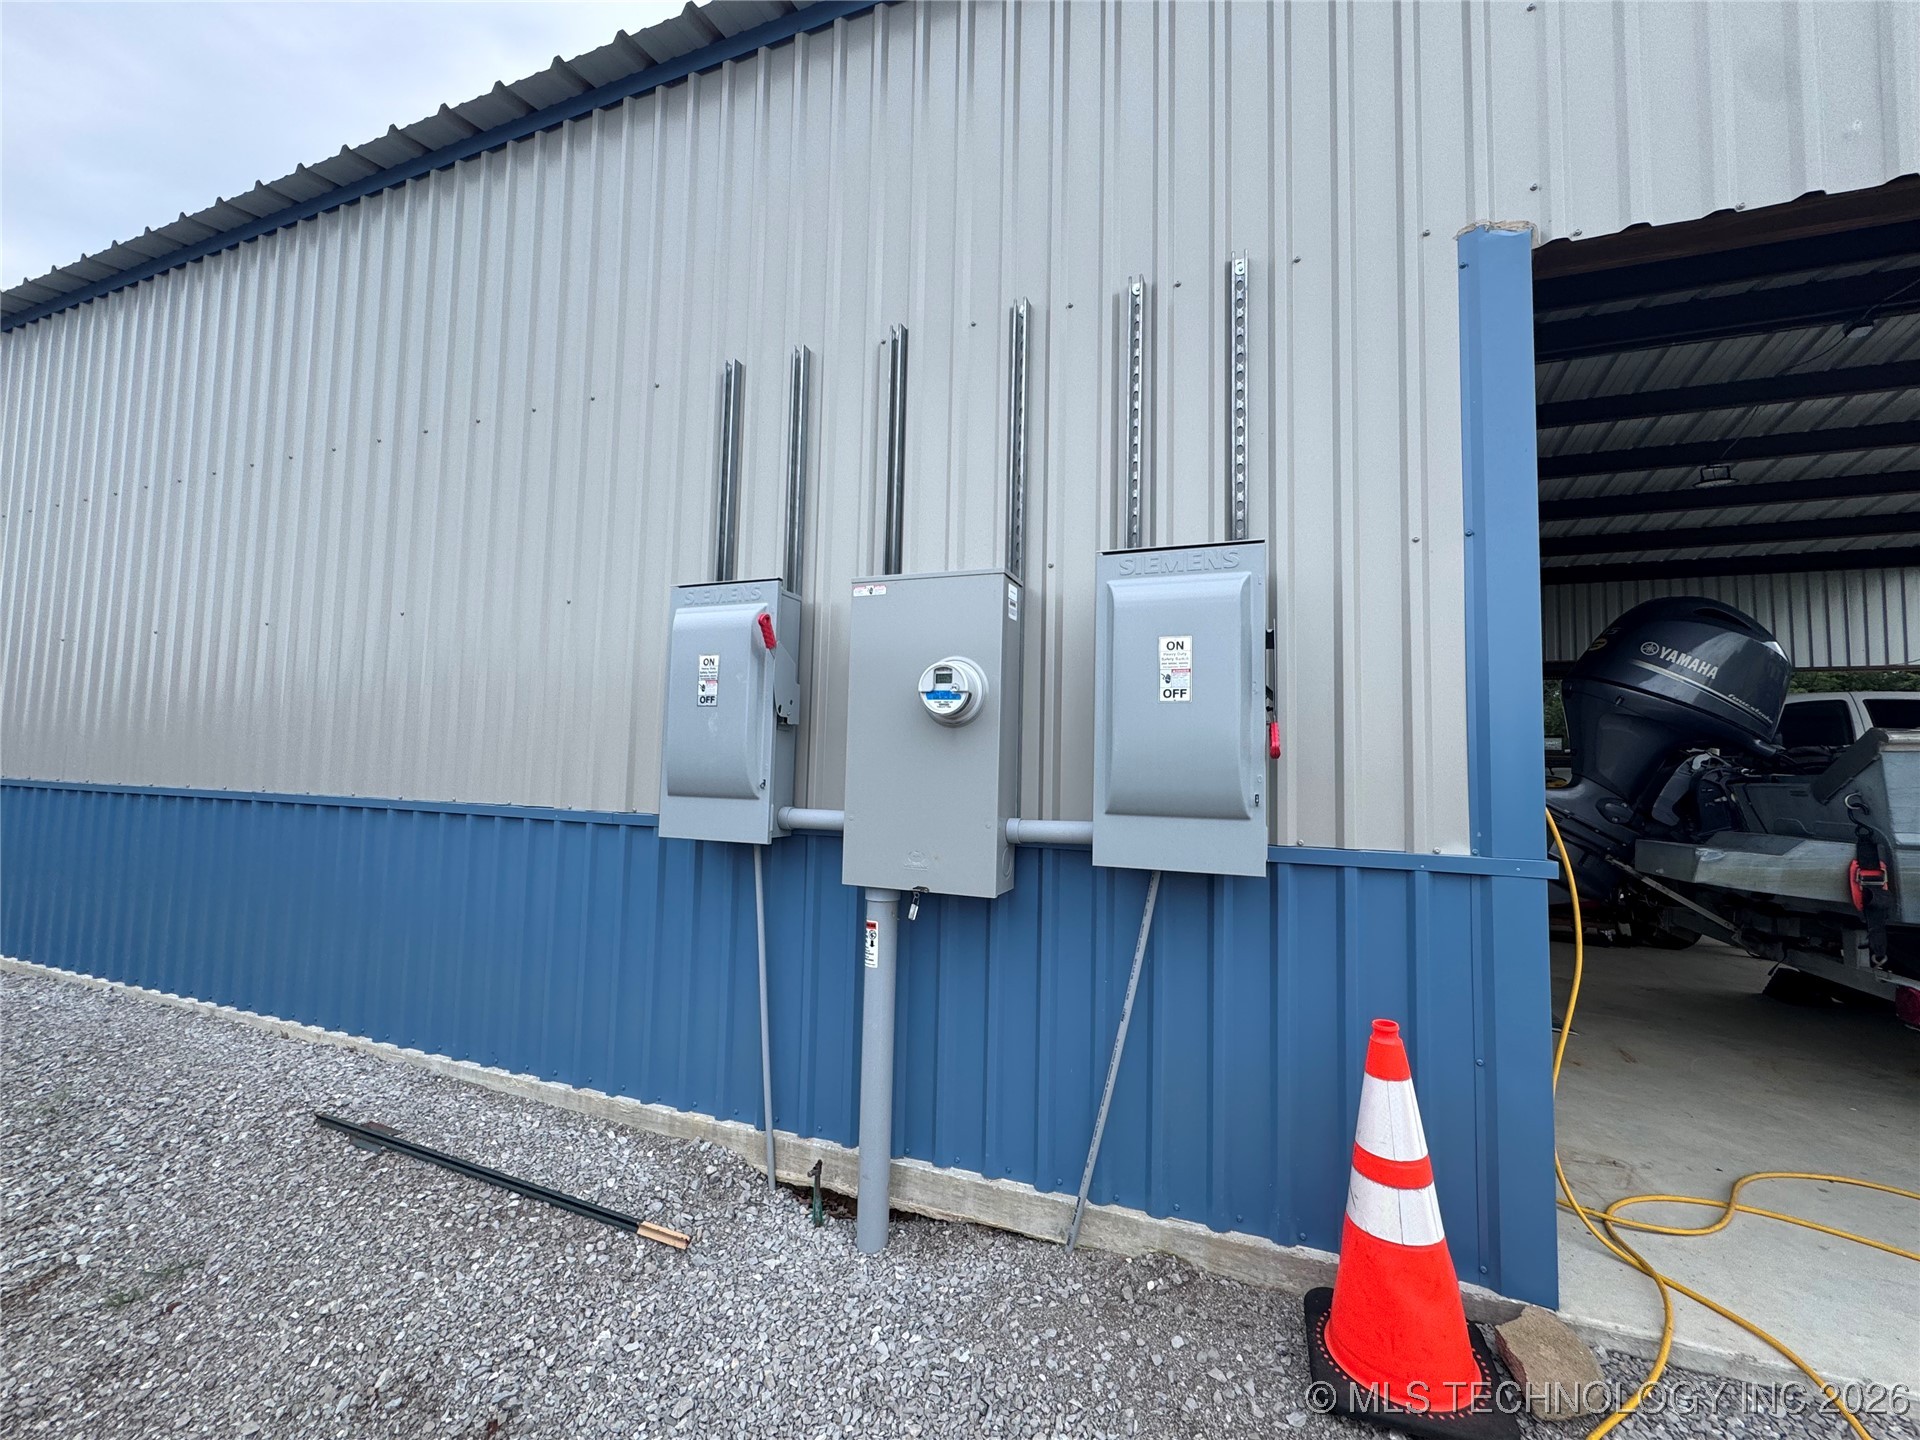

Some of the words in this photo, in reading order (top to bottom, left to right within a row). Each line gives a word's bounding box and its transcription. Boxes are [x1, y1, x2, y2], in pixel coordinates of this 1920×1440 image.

[1119, 550, 1240, 577] SIEMENS
[684, 587, 762, 606] SIEMENS
[1166, 641, 1184, 651] ON
[703, 658, 715, 666] ON
[1659, 646, 1719, 680] YAMAHA
[1163, 688, 1187, 699] OFF
[699, 695, 716, 704] OFF
